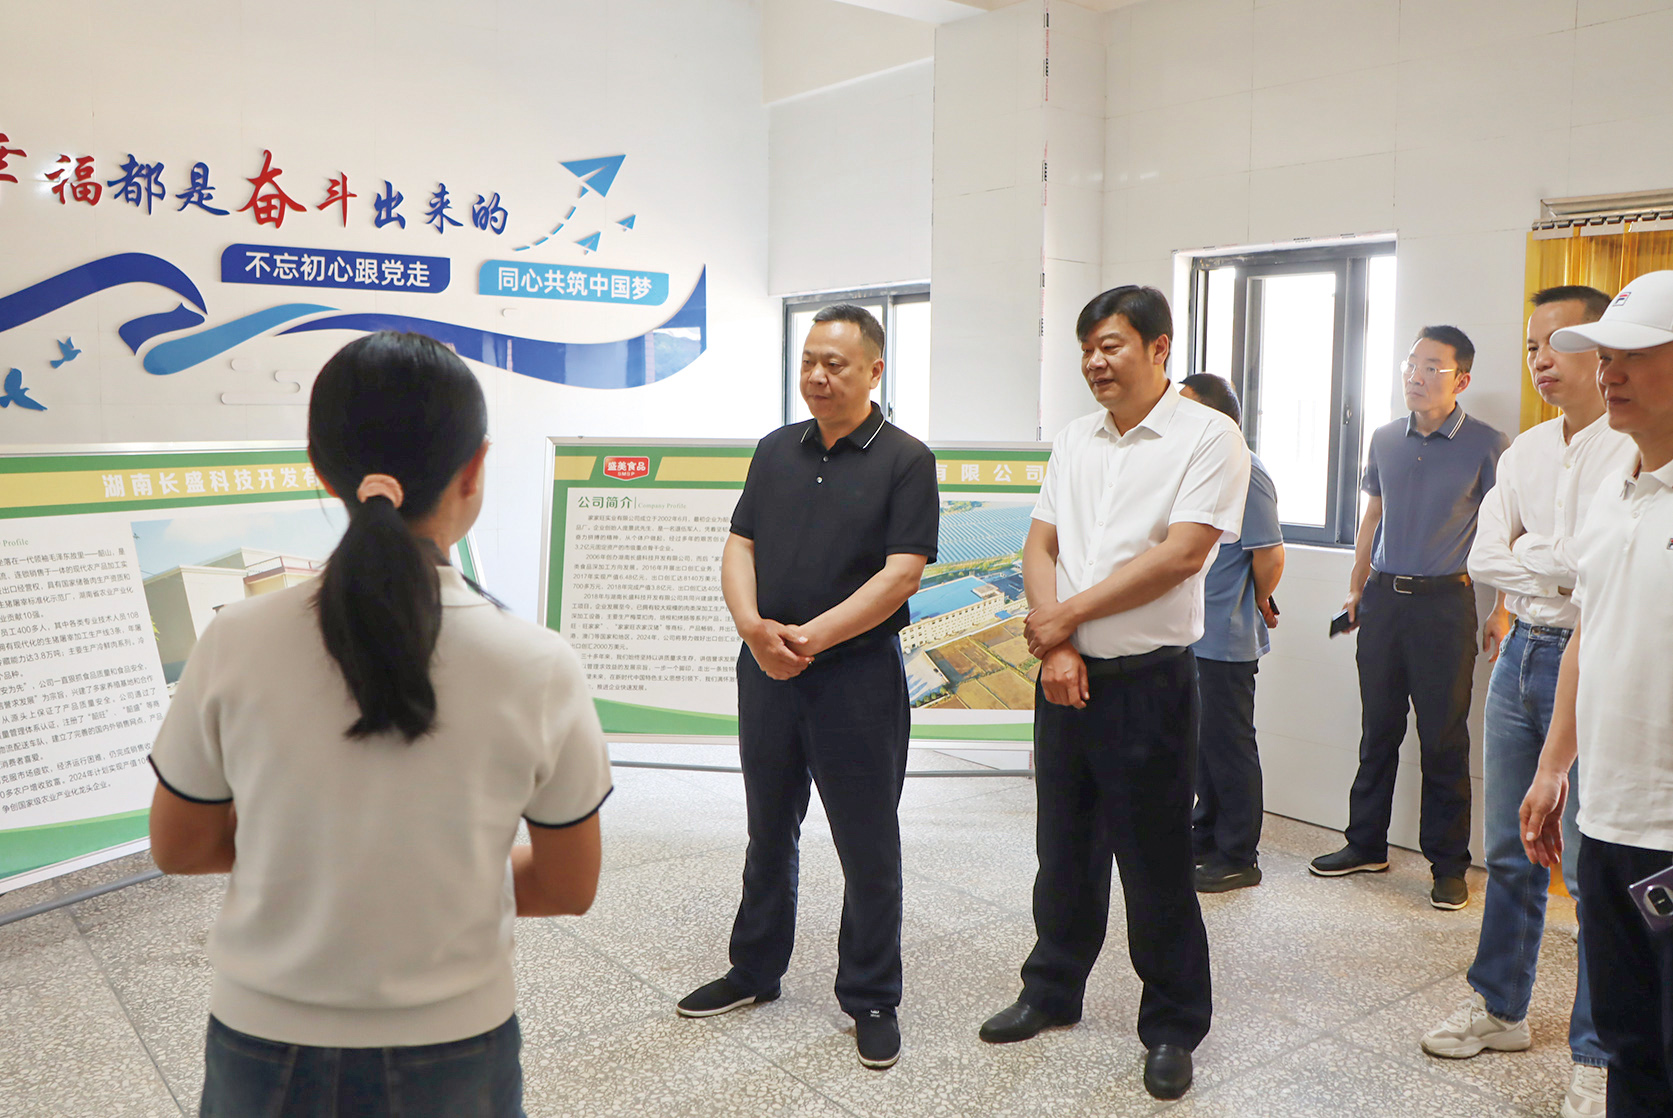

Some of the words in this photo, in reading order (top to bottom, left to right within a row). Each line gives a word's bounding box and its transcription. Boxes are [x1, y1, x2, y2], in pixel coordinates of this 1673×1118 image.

[245, 251, 430, 288] 不忘初心跟党走
[496, 266, 653, 301] 同心共筑中国梦
[607, 460, 646, 472] 盛美食品
[102, 466, 320, 498] 湖南长盛科技开发有
[577, 496, 633, 509] 公司简介
[638, 502, 665, 510] Company
[3, 538, 29, 547] Profile
[586, 554, 722, 562] 2006年创办湖南长盛科技开发有限公司，而后“家
[574, 563, 721, 572] 类食品深加工方向发展。2016年开展出口创汇业务，
[581, 653, 738, 662] 三十多年来，我们始终坚持以讲质量求生存，讲信誉求发展
[0, 752, 43, 769] 消费者喜爱。
[0, 756, 148, 799] 0多农户增收致富。2024年计划实现产值10
